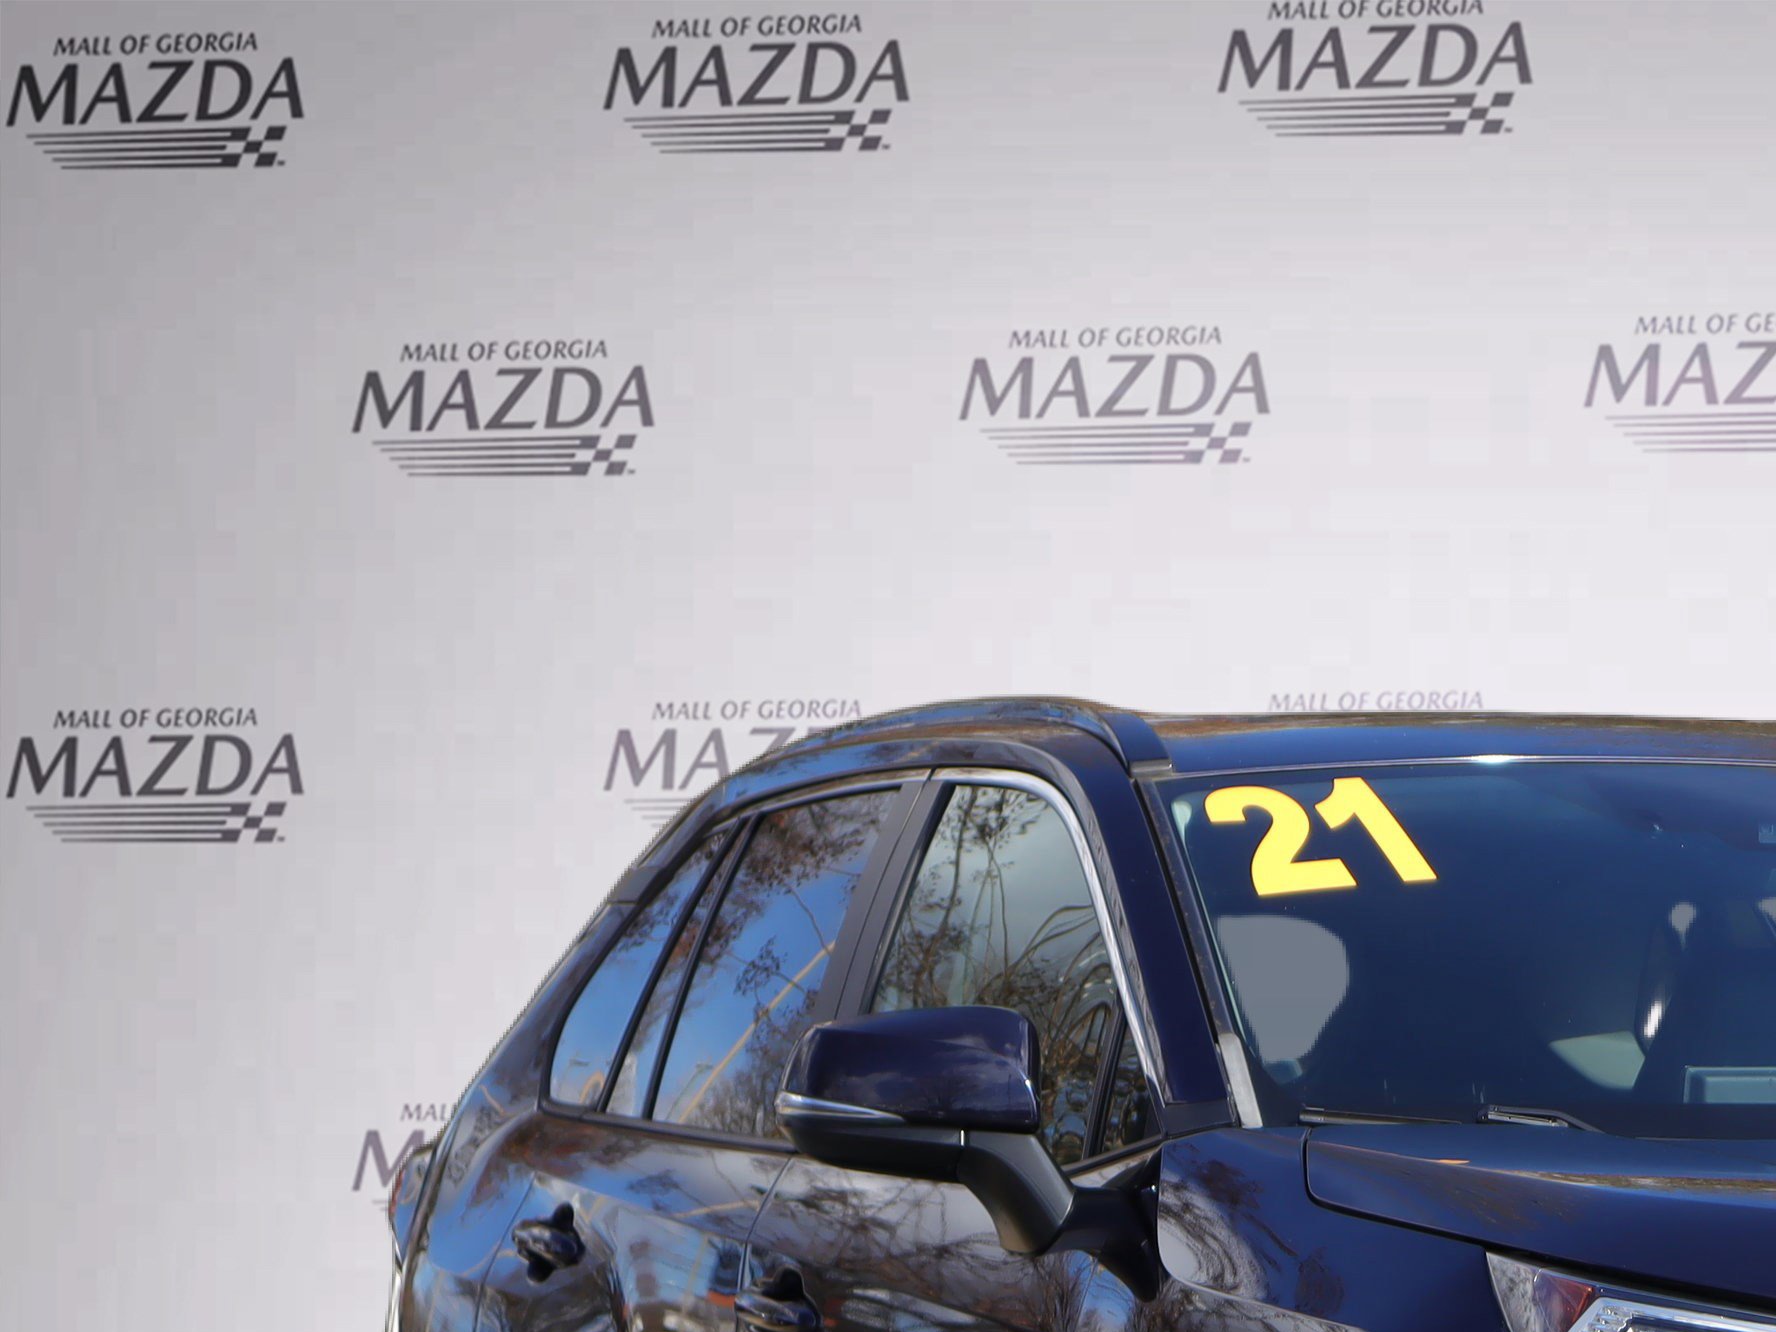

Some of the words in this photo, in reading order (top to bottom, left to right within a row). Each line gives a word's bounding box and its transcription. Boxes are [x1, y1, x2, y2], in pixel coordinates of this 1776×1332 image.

[1268, 0, 1329, 19] MALL
[1338, 0, 1369, 19] OF
[1376, 0, 1484, 18] GEORGIA
[652, 19, 712, 37] MALL
[720, 16, 752, 37] OF
[757, 14, 862, 36] GEORGIA
[53, 36, 112, 56] MALL
[120, 34, 151, 55] OF
[156, 32, 258, 54] GEORGIA
[1217, 21, 1533, 93] MAZDA
[603, 38, 909, 110] MAZDA
[6, 57, 304, 127] MAZDA
[1635, 315, 1697, 334] MALL
[1706, 313, 1738, 334] OF
[1009, 330, 1069, 348] MALL
[1078, 328, 1109, 348] OF
[1116, 326, 1222, 348] GEORGIA
[400, 343, 459, 362] MALL
[467, 341, 499, 362] OF
[504, 340, 608, 362] GEORGIA
[959, 352, 1271, 421] MAZDA
[352, 365, 655, 433] MAZDA
[652, 702, 711, 720] MALL
[720, 701, 752, 720] OF
[757, 700, 862, 719] GEORGIA
[1269, 693, 1330, 712] MALL
[1338, 692, 1371, 712] OF
[1376, 690, 1485, 711] GEORGIA
[53, 709, 112, 729] MALL
[120, 708, 151, 728] OF
[156, 707, 258, 728] GEORGIA
[6, 734, 304, 798] MAZDA
[1204, 776, 1438, 896] 21
